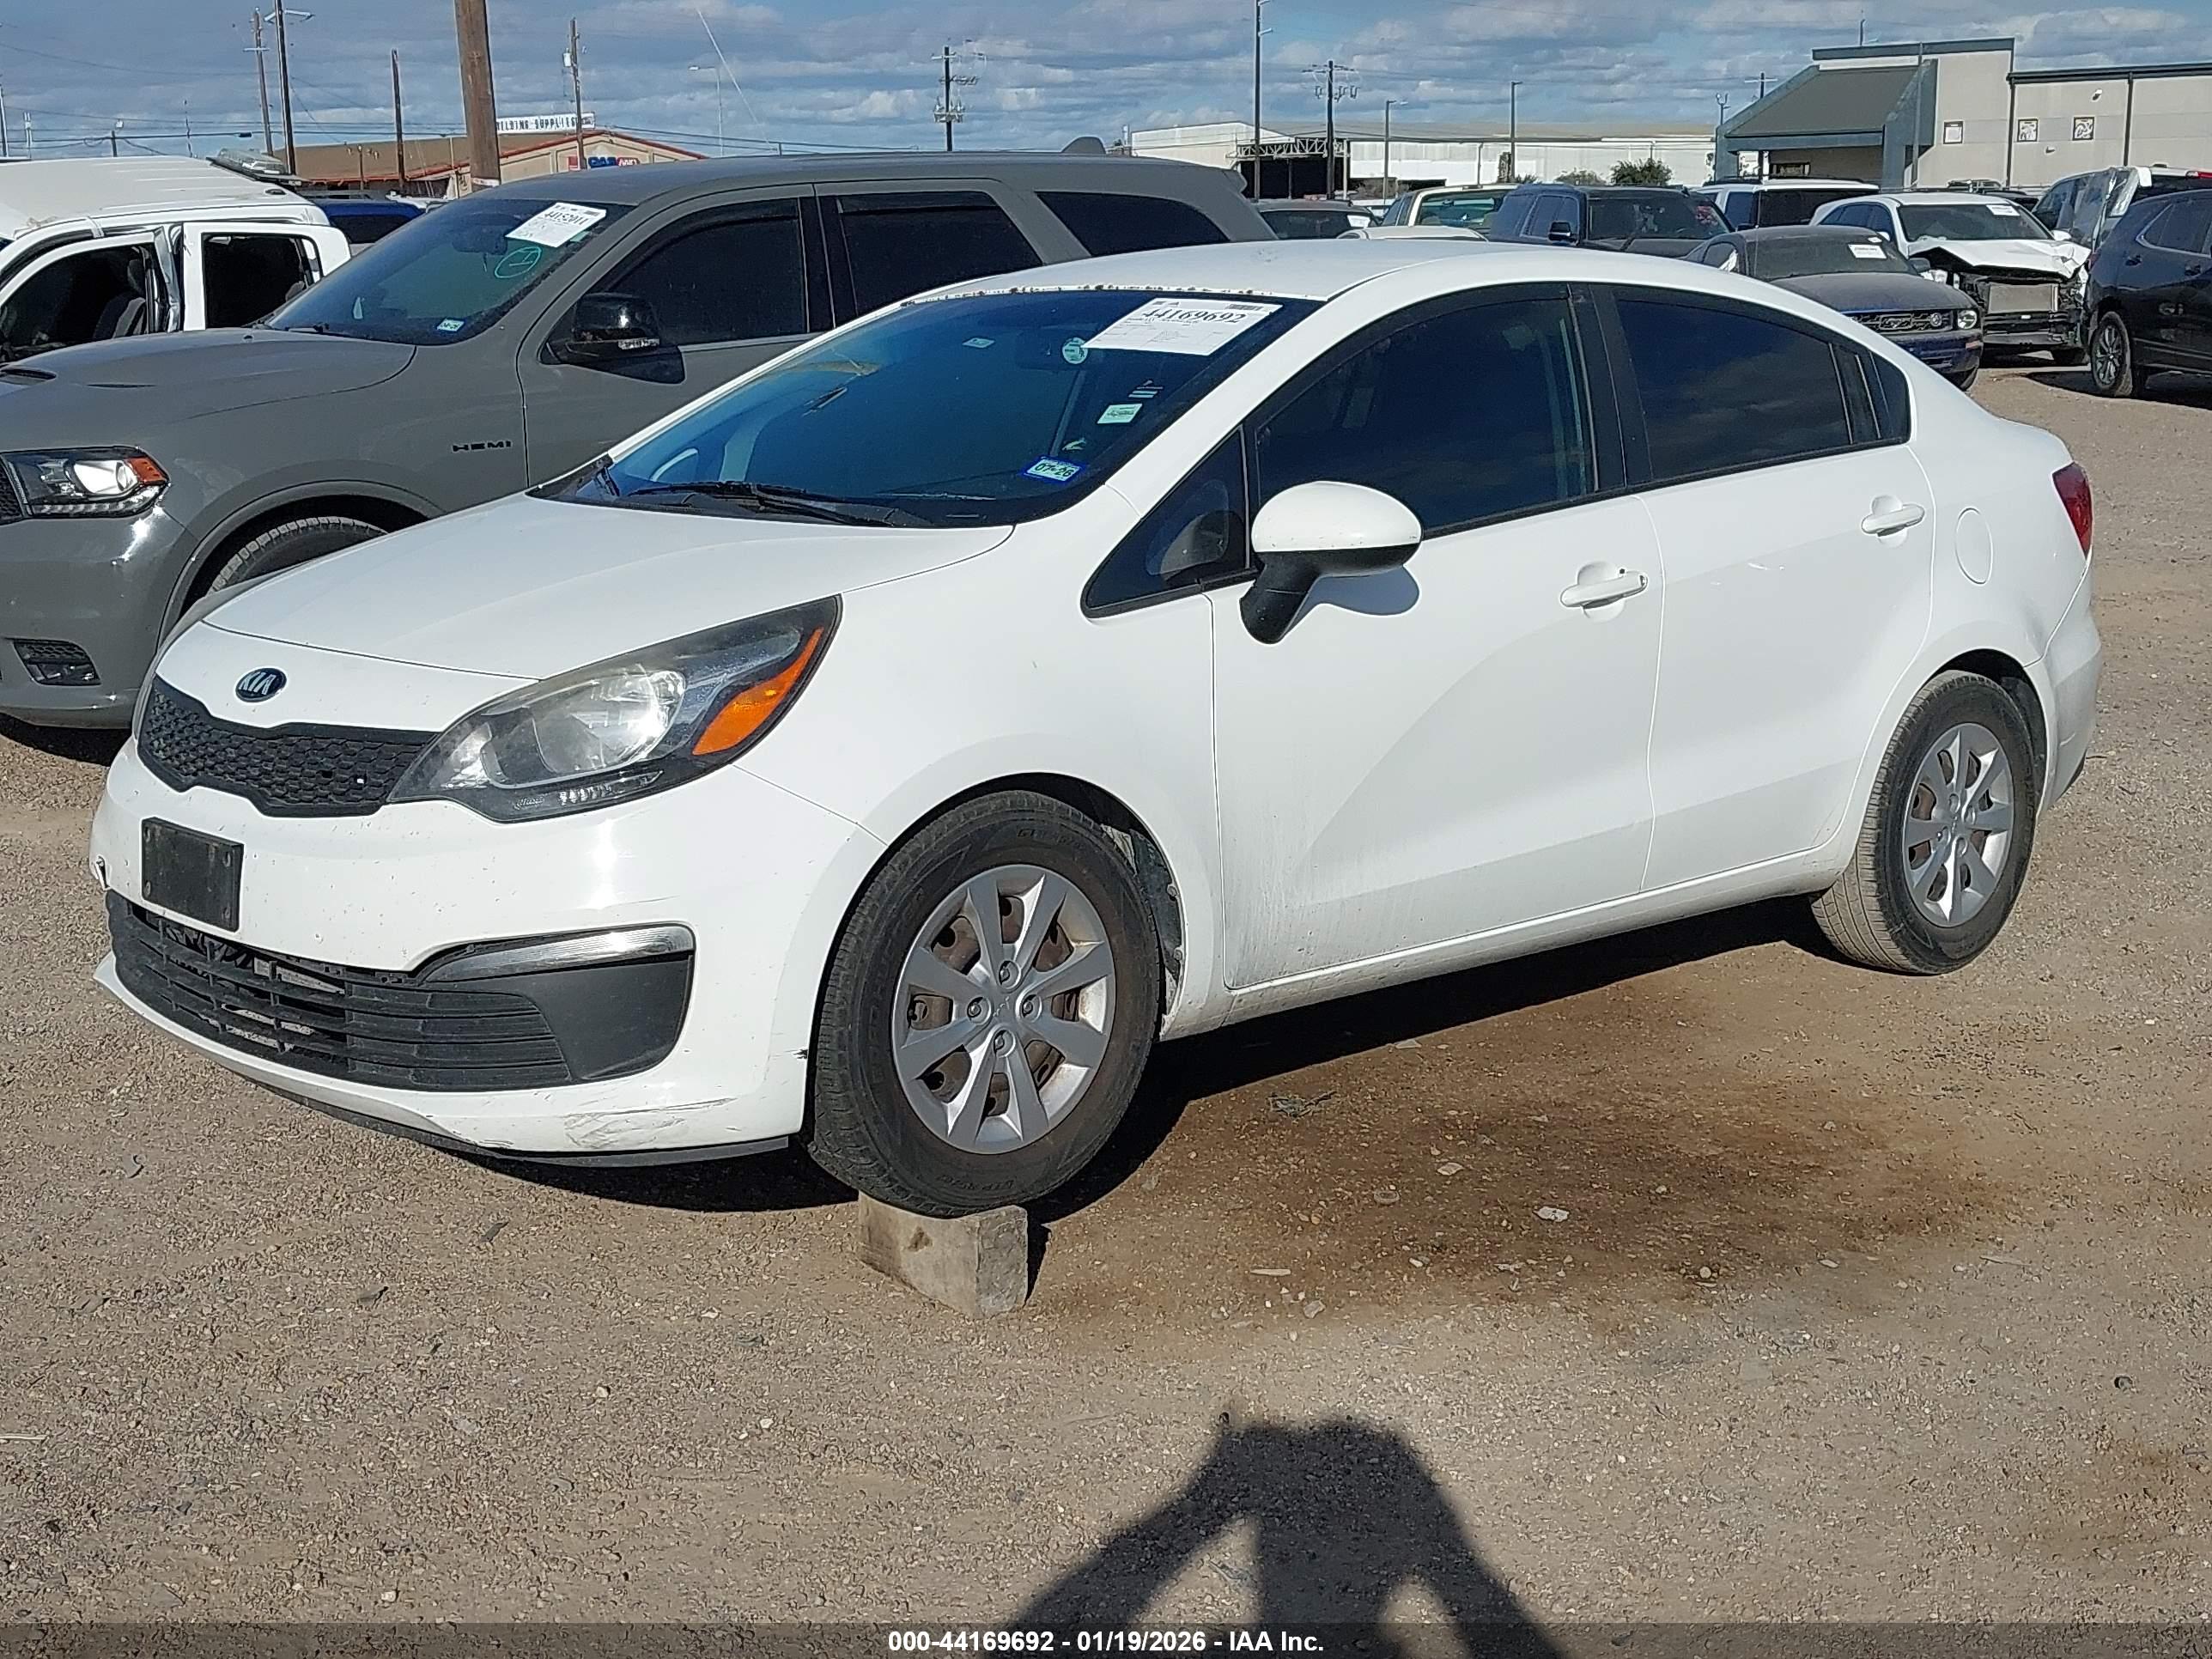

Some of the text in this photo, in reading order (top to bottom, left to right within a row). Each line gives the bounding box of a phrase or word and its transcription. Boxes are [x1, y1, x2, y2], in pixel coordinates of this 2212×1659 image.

[1143, 308, 1247, 324] 44169692
[453, 441, 512, 452] HEMI
[238, 671, 277, 696] KIA
